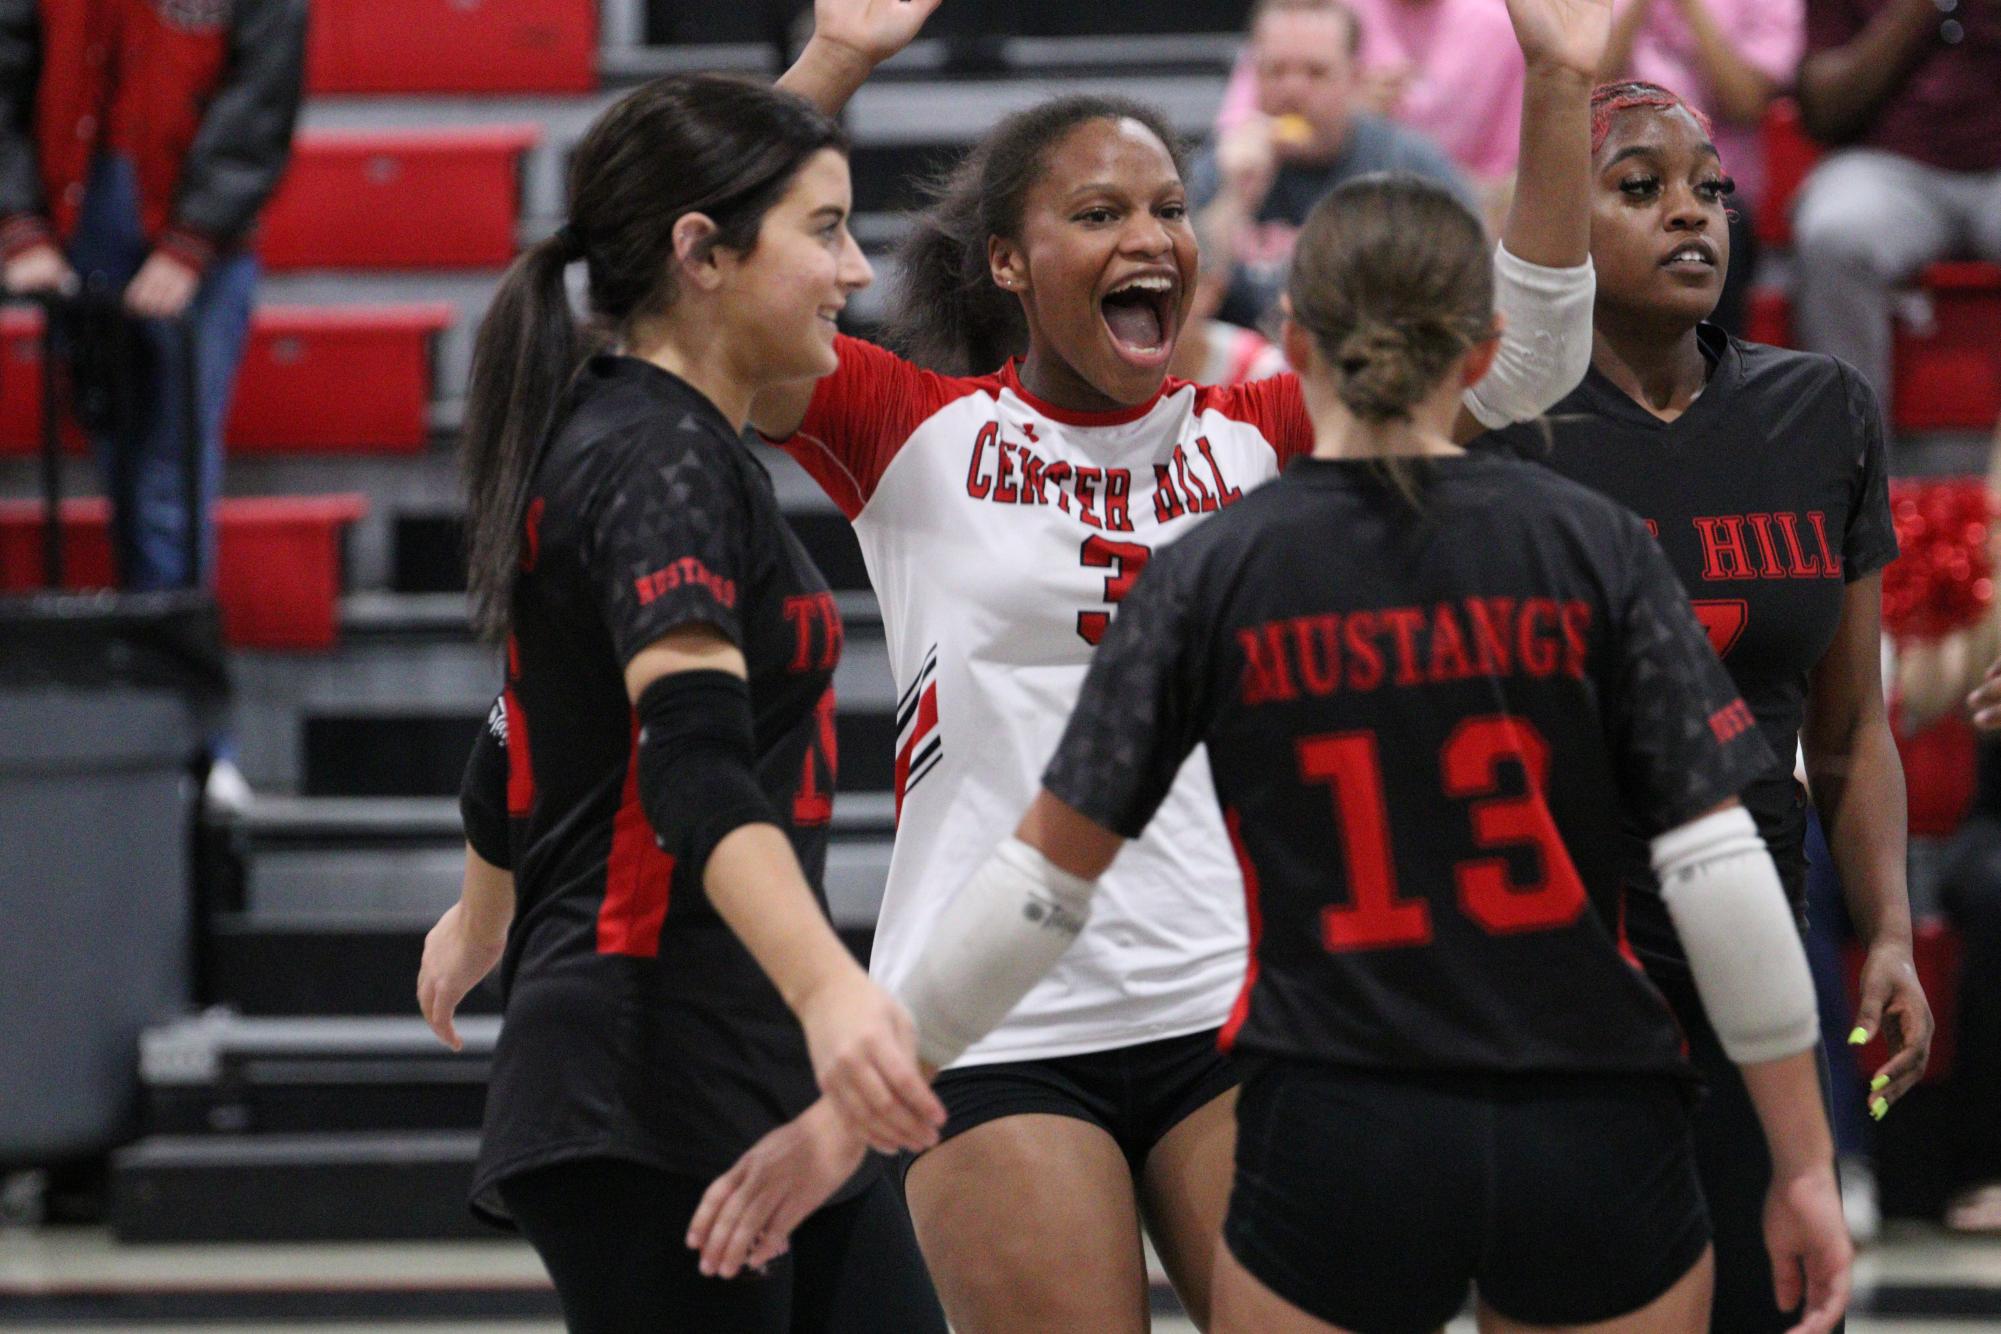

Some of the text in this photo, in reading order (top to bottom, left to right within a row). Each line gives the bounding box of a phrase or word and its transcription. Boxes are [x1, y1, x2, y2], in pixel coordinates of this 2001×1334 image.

[967, 421, 1243, 532] CENTER HILL
[1692, 511, 1842, 580] HILL
[1237, 595, 1592, 705] MUSTANGS
[1298, 713, 1589, 952] 13
